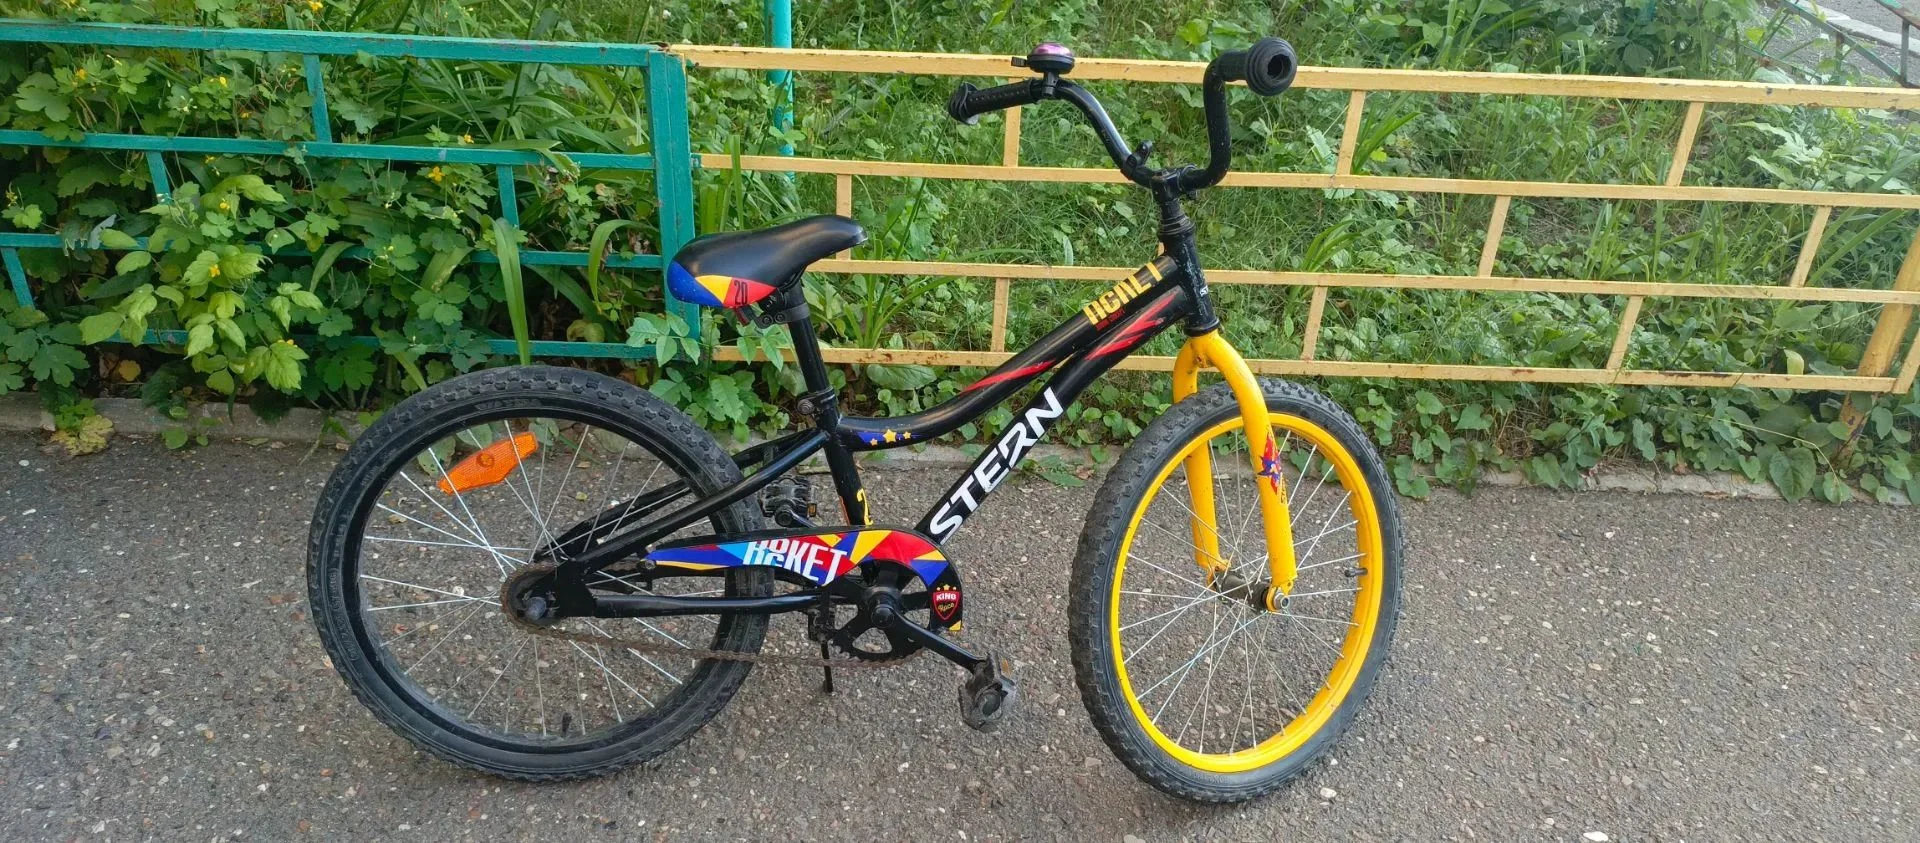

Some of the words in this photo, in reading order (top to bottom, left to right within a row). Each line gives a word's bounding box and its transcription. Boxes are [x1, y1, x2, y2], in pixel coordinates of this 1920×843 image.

[733, 280, 749, 305] 20
[929, 387, 1064, 546] STERN
[936, 592, 957, 602] KING
